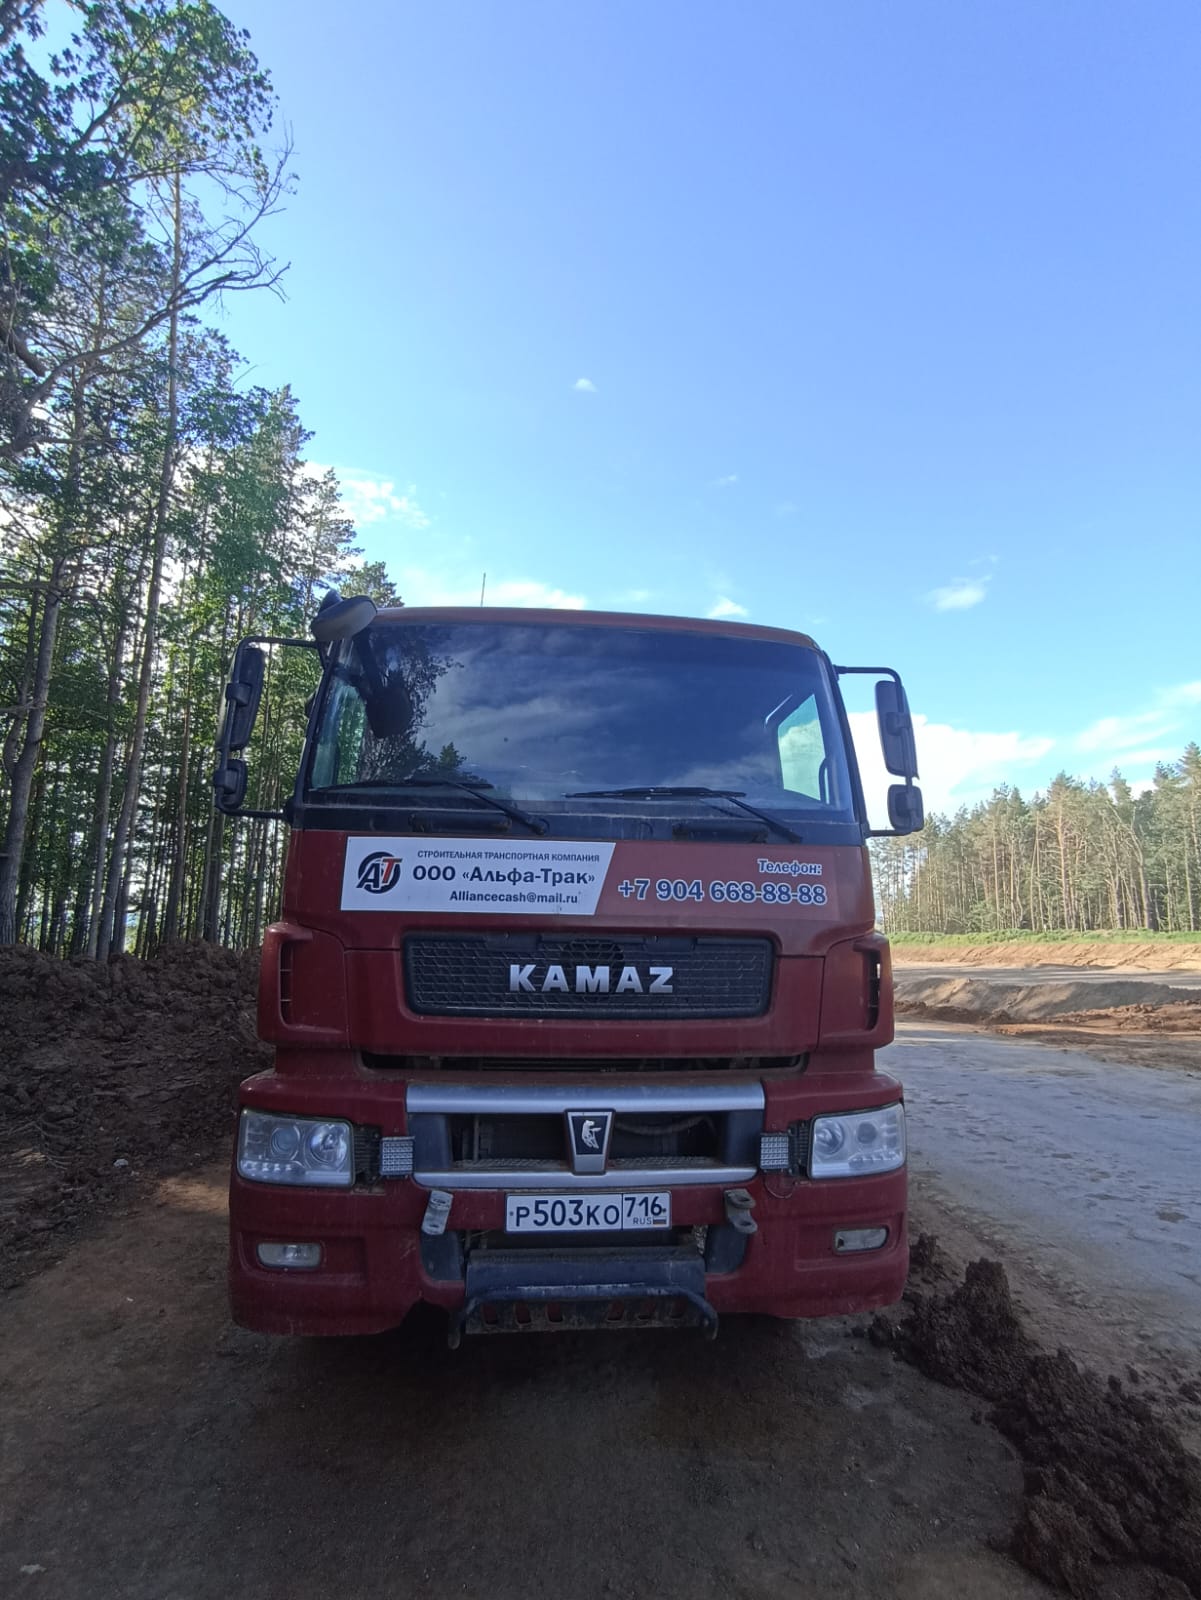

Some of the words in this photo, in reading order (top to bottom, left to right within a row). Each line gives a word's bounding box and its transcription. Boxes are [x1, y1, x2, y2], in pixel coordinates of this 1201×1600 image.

[417, 849, 483, 860] СТРОИТЕЛЬНАЯ
[485, 851, 550, 862] ТРАНСПОРТНАЯ
[551, 853, 600, 863] КОМПАНИЯ
[412, 864, 456, 881] ООО
[462, 866, 596, 887] «Альфа-Трак»
[757, 858, 823, 876] Телефон:
[449, 890, 578, 904] Alliancecash@mail.ru
[618, 879, 650, 900] +7
[656, 879, 703, 902] 904
[709, 881, 827, 905] 668-88-88
[509, 964, 674, 994] KAMAZ
[632, 1216, 652, 1225] RUS
